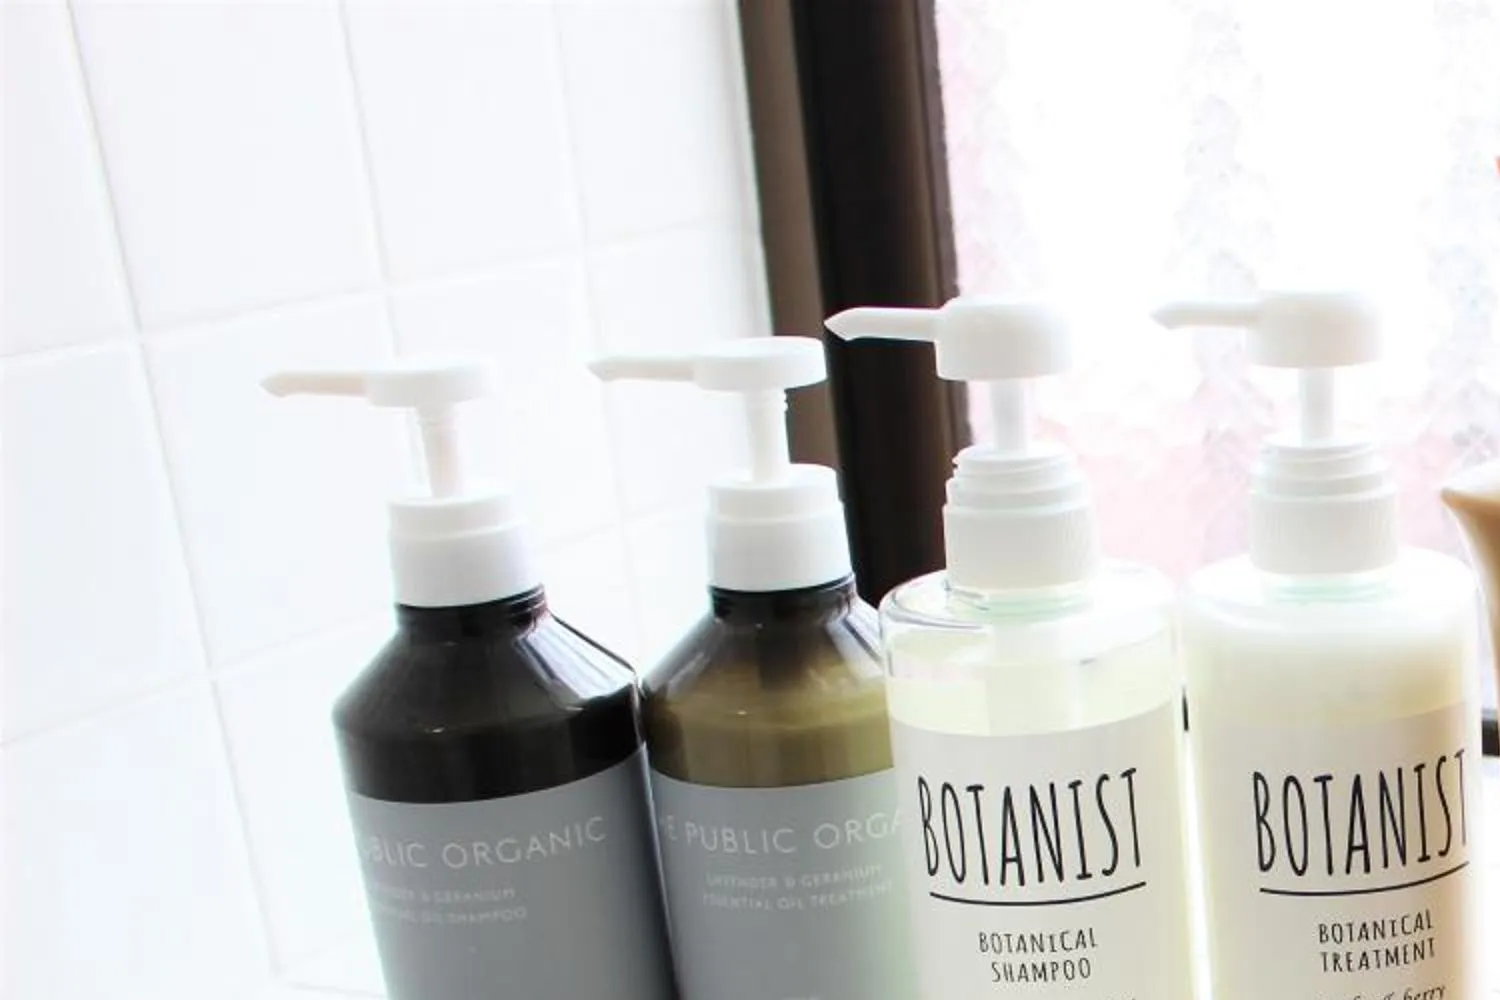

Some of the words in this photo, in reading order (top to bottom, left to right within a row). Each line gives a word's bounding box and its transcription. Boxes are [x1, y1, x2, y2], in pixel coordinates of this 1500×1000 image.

[917, 766, 1142, 887] BOTANIST
[1252, 748, 1467, 876] BOTANIST
[441, 816, 606, 869] ORGANIC
[684, 820, 797, 855] PUBLIC
[977, 926, 1100, 955] BOTANICAL
[1318, 908, 1435, 944] BOTANICAL
[990, 955, 1093, 983] SHAMPOO
[1320, 938, 1436, 974] TREATMENT
